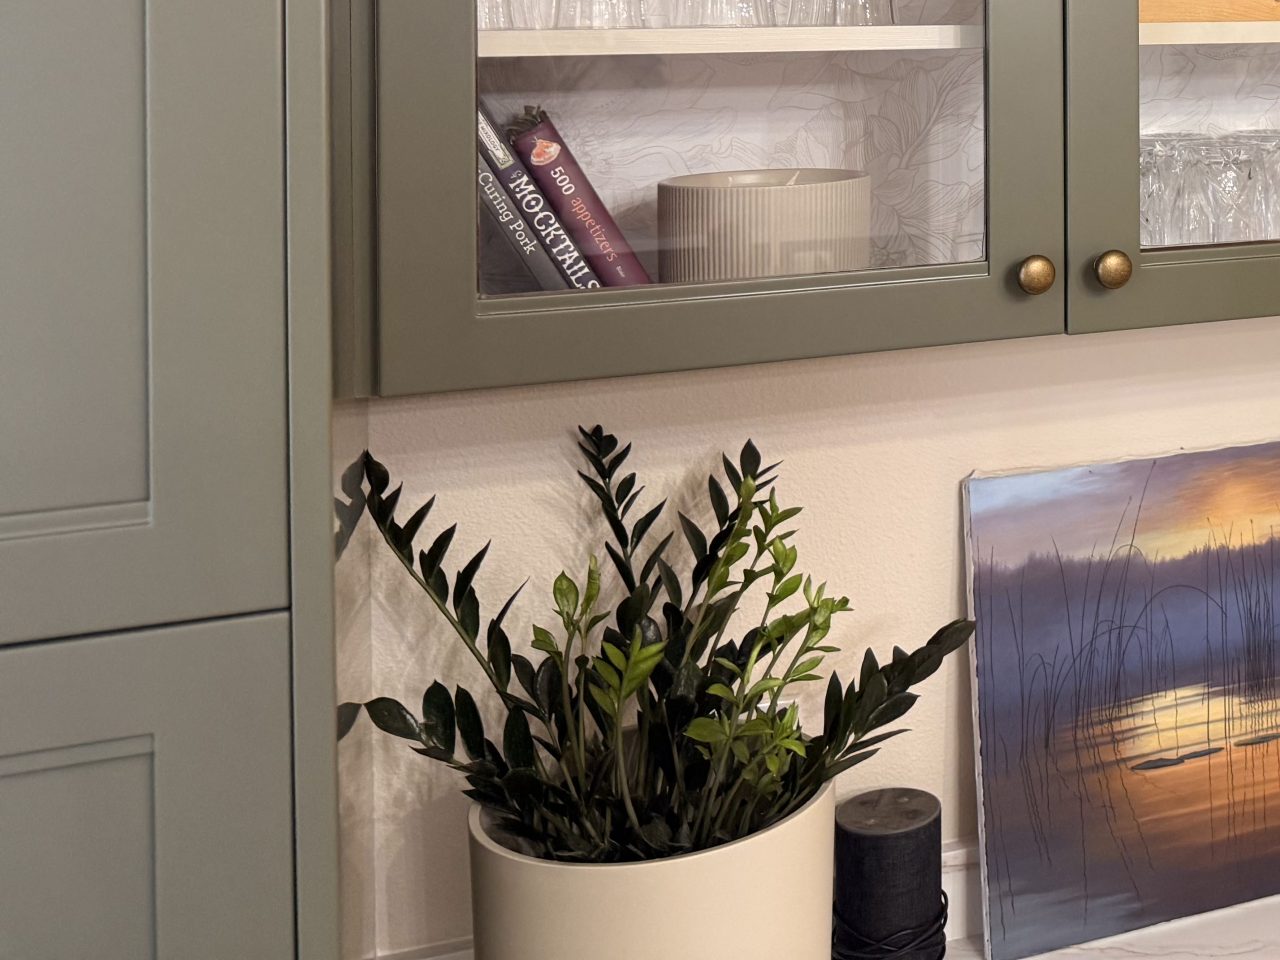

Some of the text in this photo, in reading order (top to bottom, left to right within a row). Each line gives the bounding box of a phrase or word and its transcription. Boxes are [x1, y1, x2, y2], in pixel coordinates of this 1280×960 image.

[479, 172, 537, 255] Curing Pork
[550, 166, 618, 262] 500 appetizers
